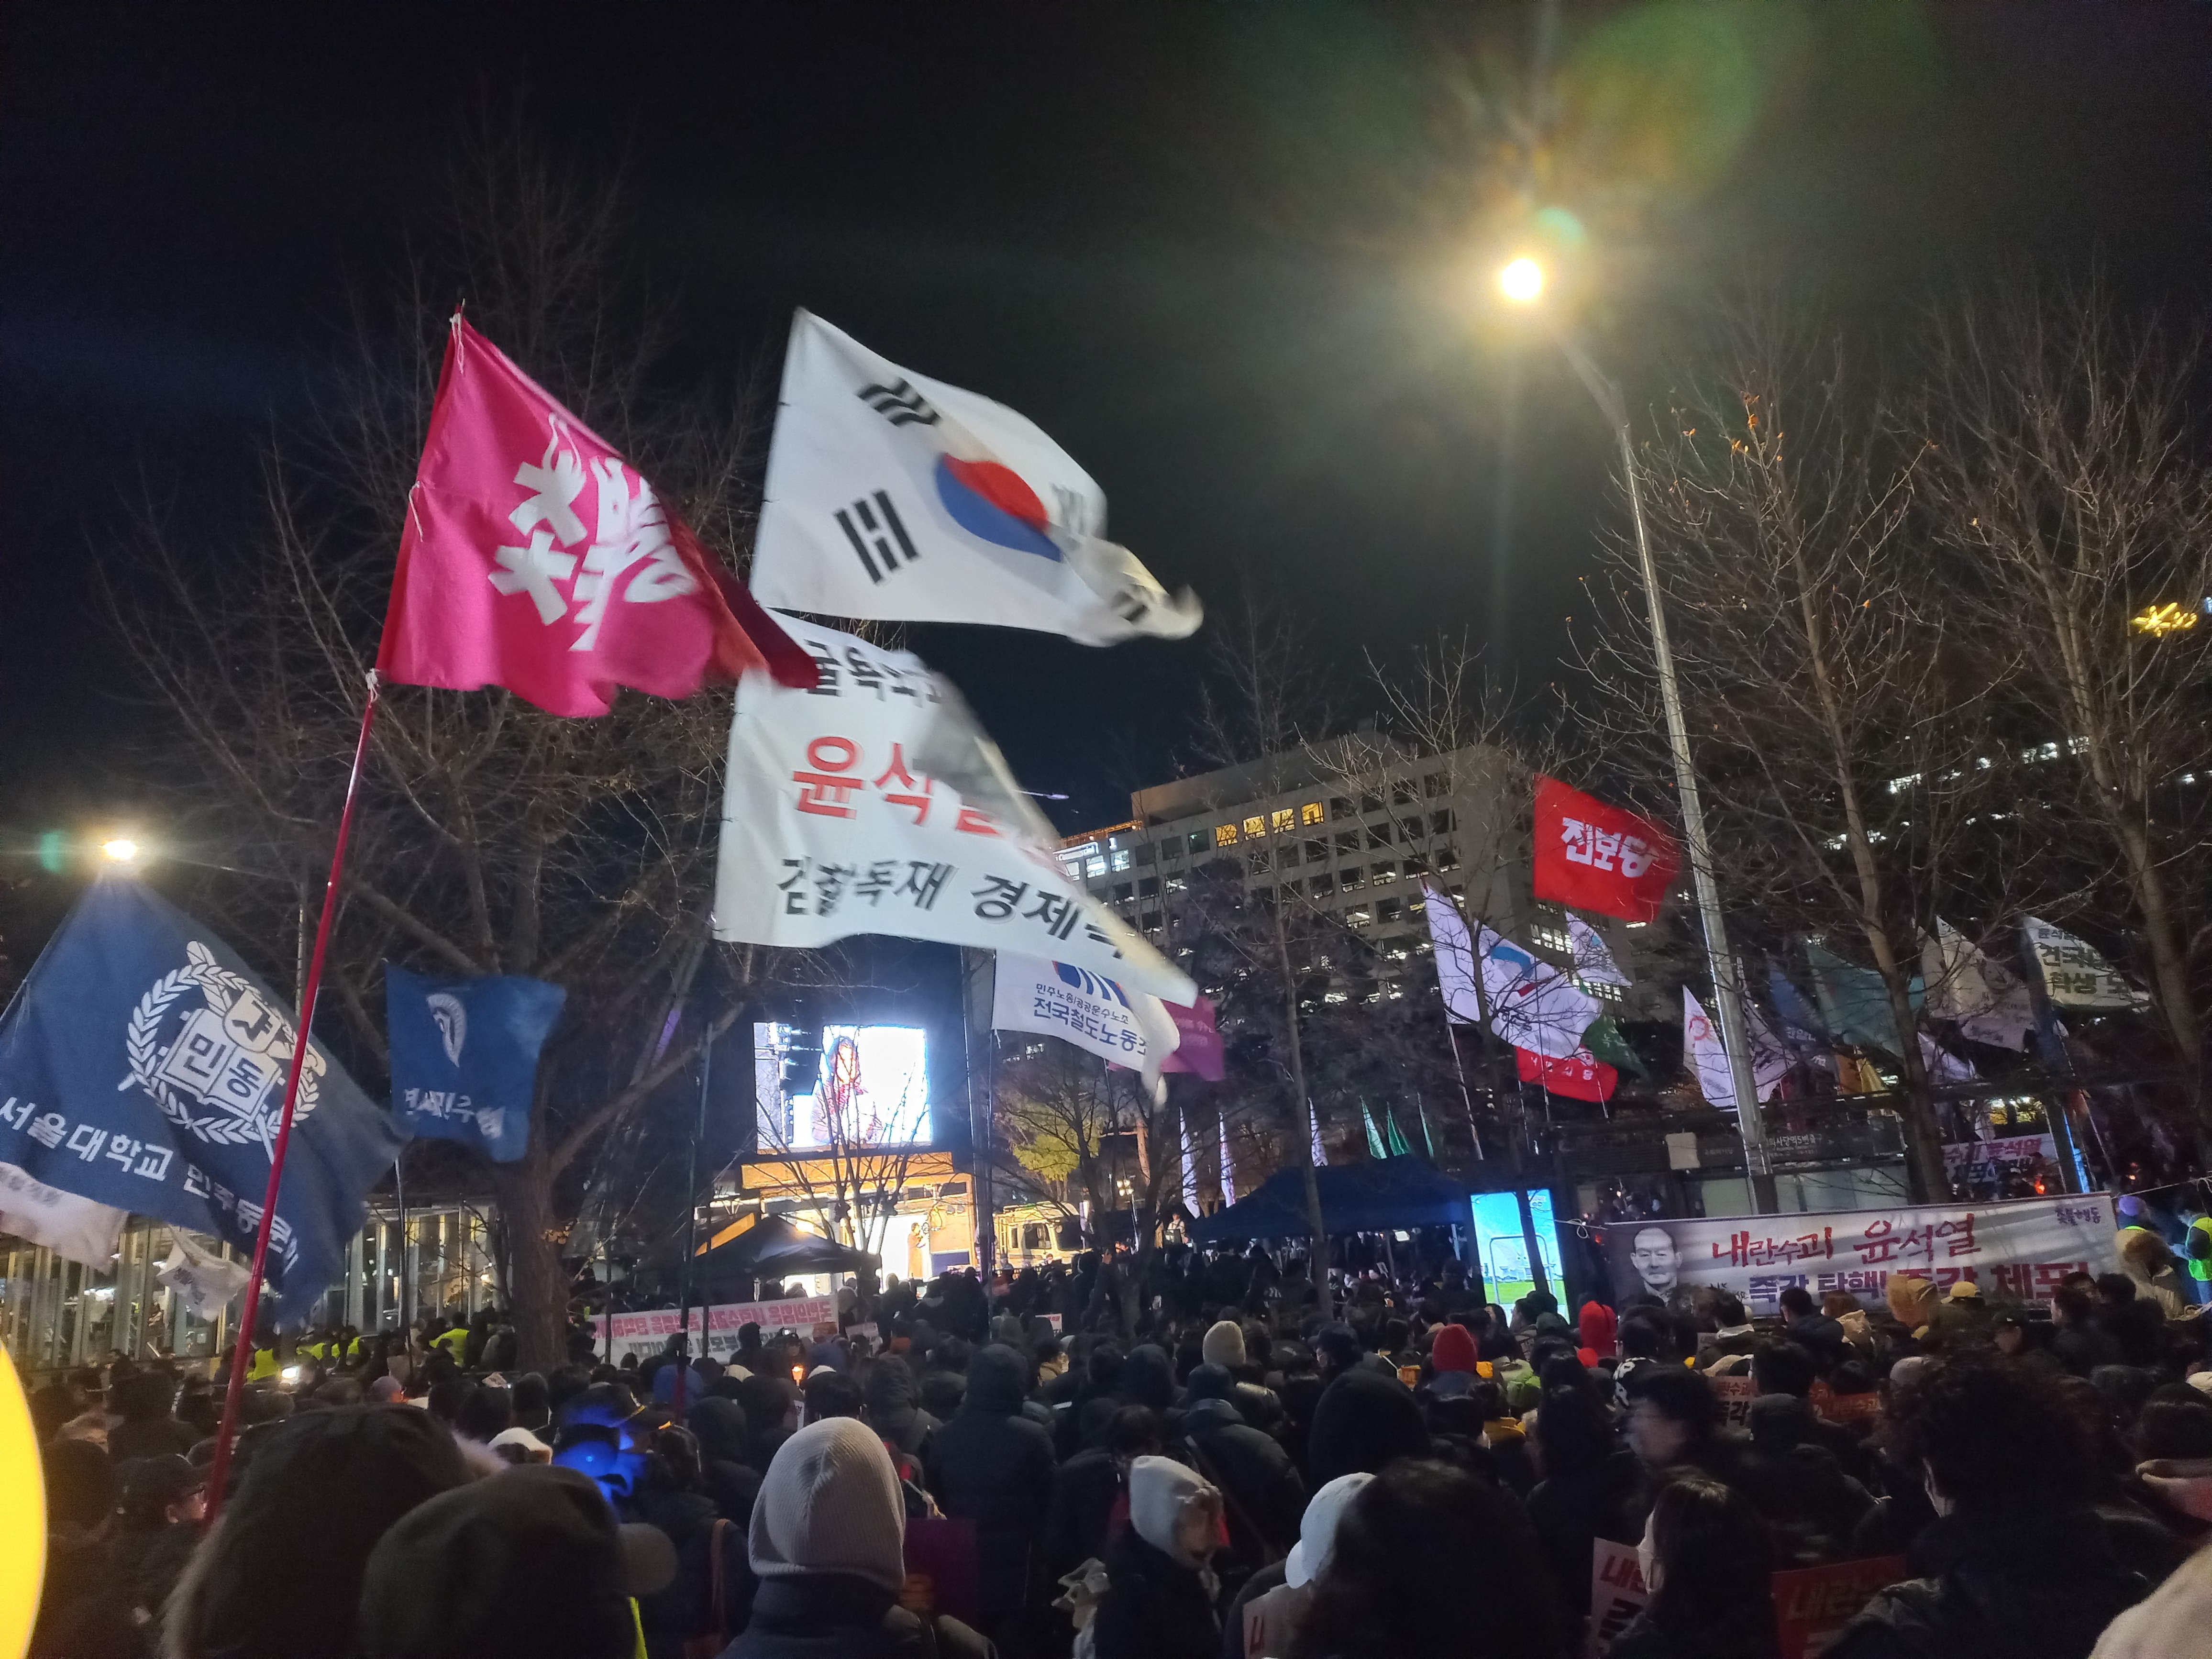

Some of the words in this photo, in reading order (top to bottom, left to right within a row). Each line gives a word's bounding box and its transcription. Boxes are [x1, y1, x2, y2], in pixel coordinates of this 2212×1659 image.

[1560, 817, 1659, 878] 진보당
[0, 1096, 173, 1182] 서울대학교
[1713, 1226, 1834, 1267] 내란수괴
[1853, 1213, 1982, 1264] 윤석열
